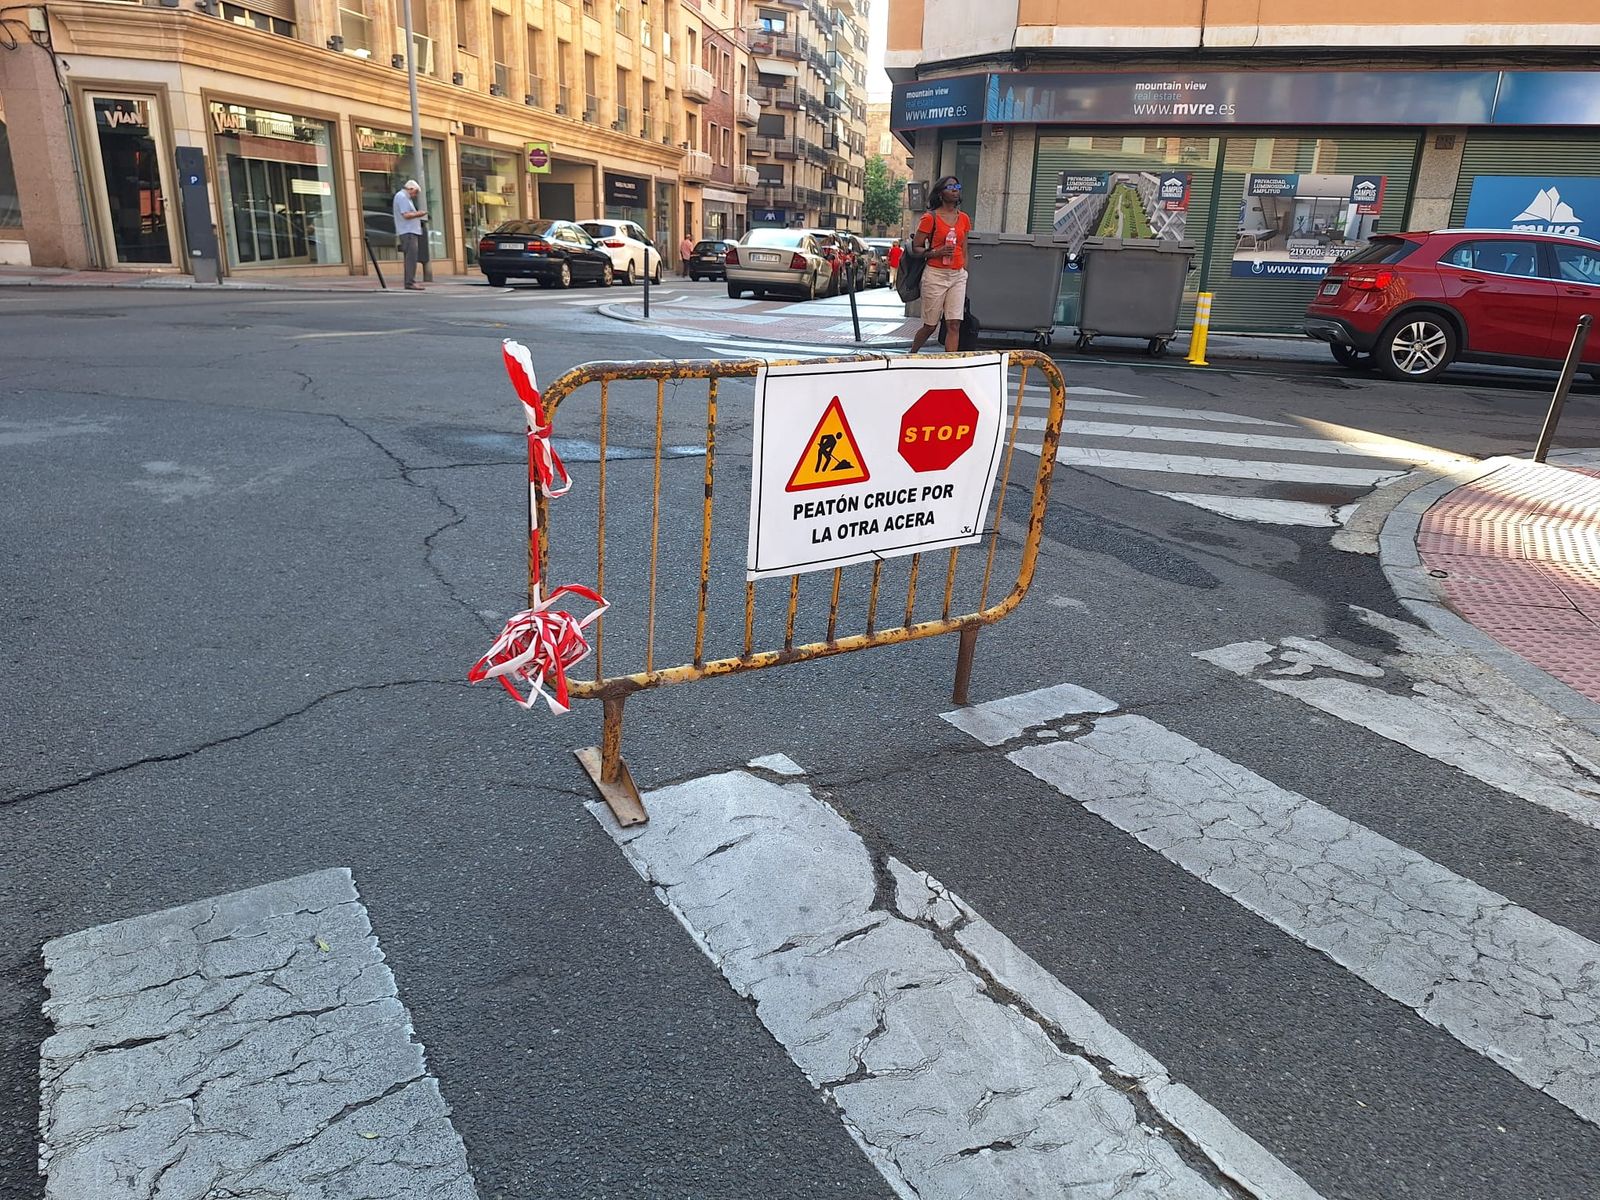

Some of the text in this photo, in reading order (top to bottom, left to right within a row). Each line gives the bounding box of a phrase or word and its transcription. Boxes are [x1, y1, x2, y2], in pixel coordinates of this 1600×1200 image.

[1135, 81, 1207, 91] mountain view
[906, 87, 949, 99] mountain view
[1134, 92, 1182, 101] real estate
[905, 105, 967, 121] www.mvre.es
[1133, 103, 1236, 115] www.mvre.es
[190, 176, 198, 184] P
[1161, 185, 1184, 193] CAMPUS
[1353, 188, 1377, 197] CAMPUS
[904, 425, 970, 443] STOP
[793, 484, 954, 520] PEATÓN CRUCE POR
[811, 511, 935, 544] LA OTRA ACERA
